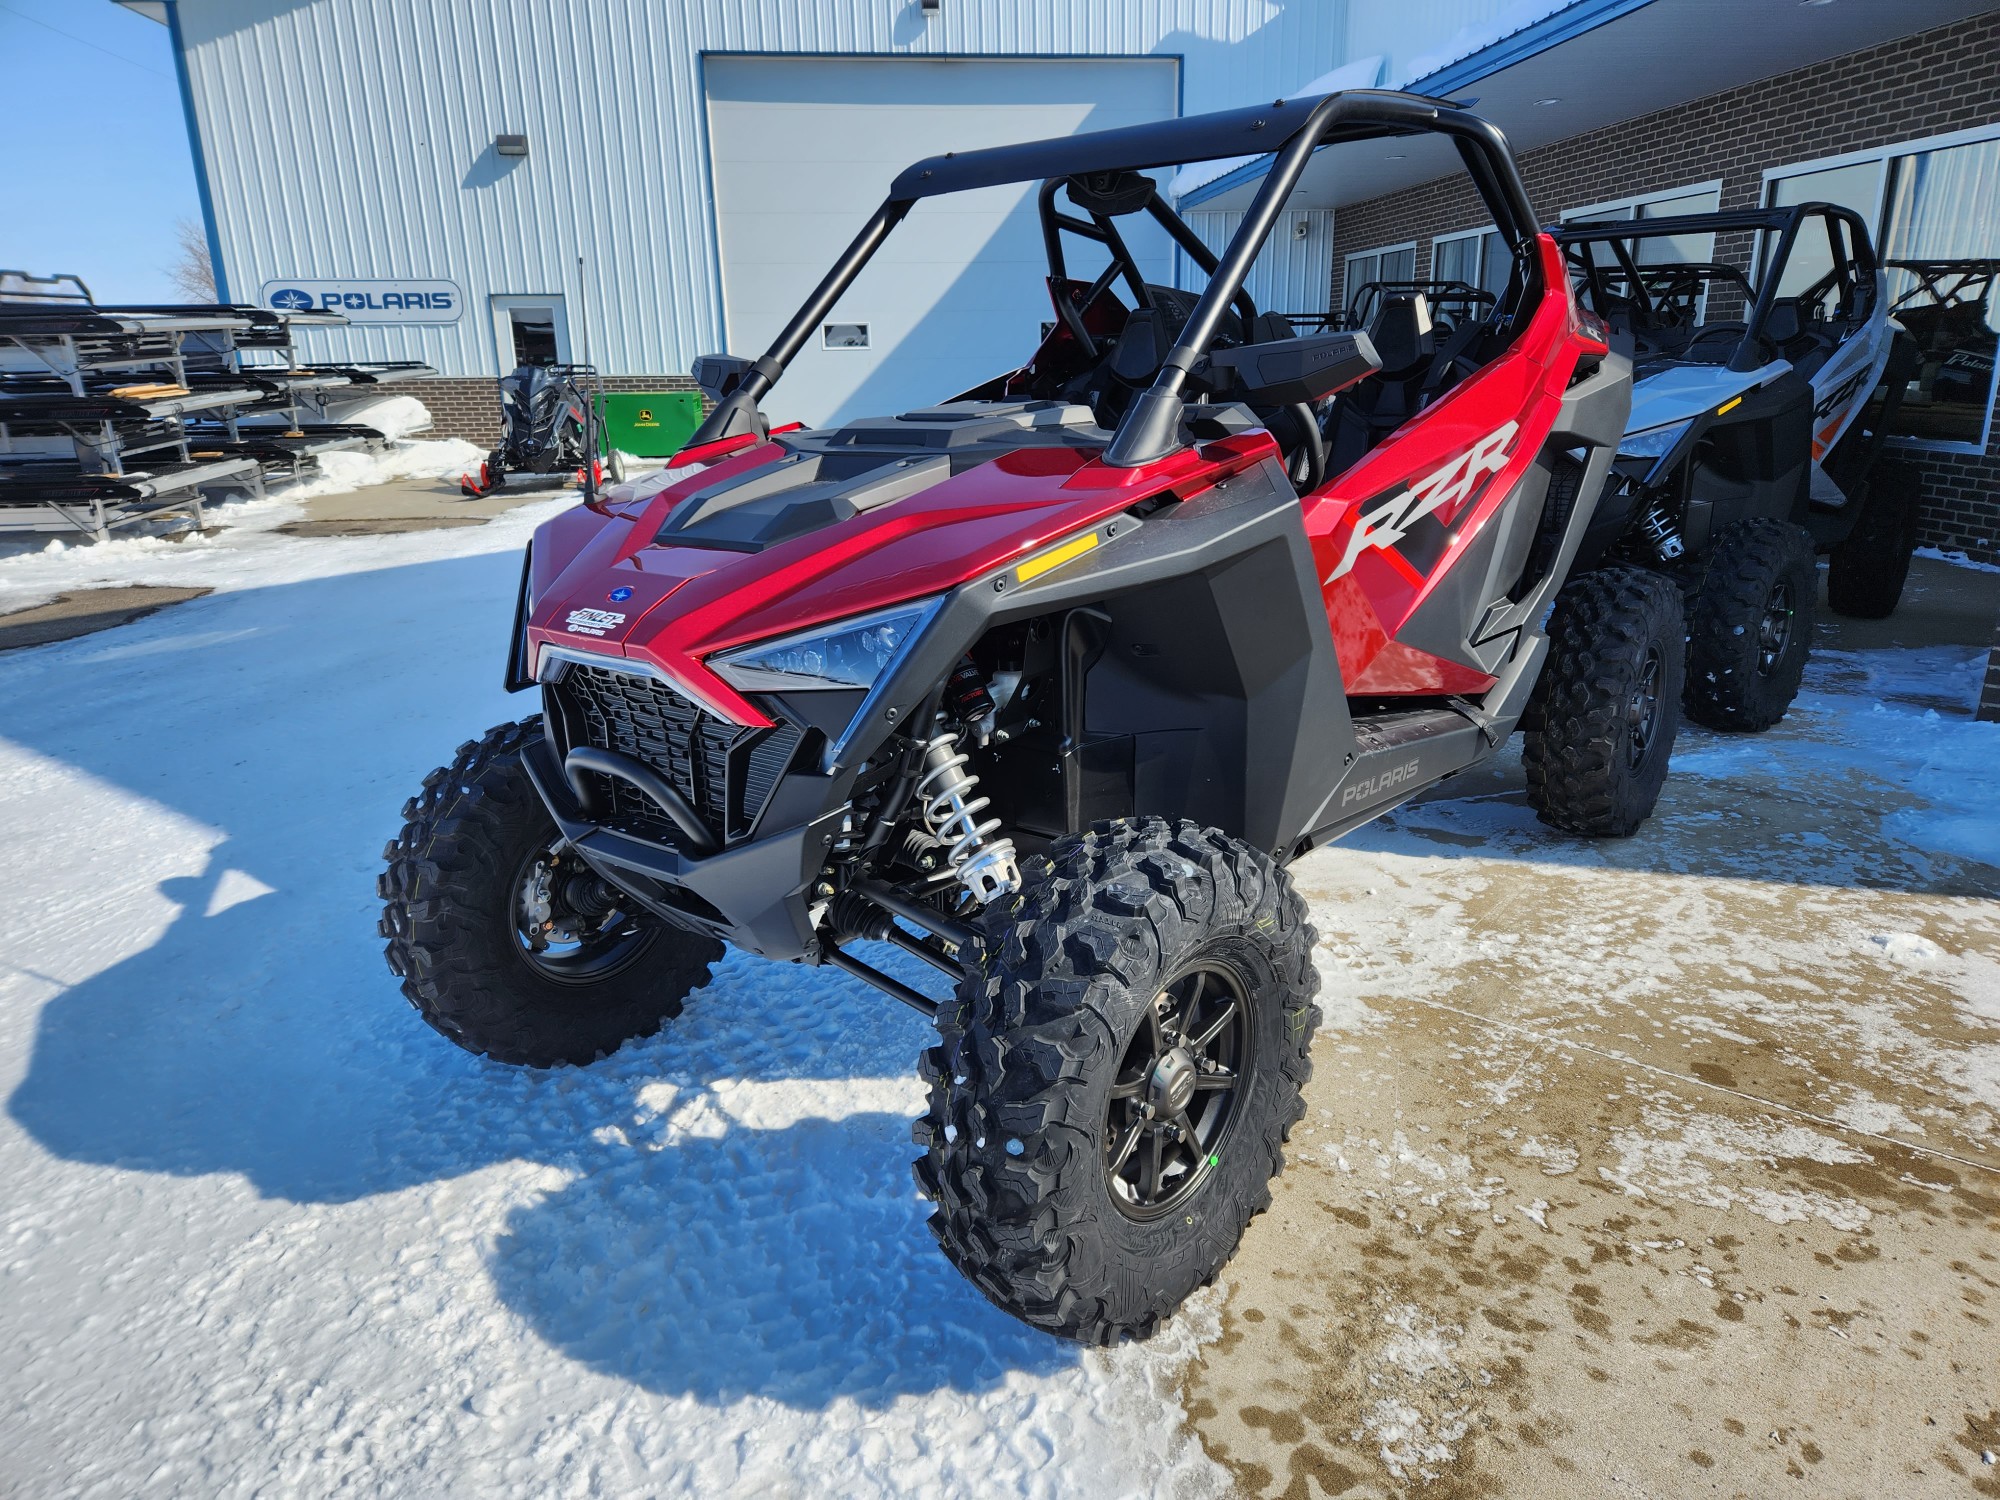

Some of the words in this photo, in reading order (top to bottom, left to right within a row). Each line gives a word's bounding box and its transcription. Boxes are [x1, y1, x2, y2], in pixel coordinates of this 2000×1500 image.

[321, 293, 452, 309] POLARIS
[1323, 420, 1519, 586] RZR
[577, 626, 606, 636] POLARIS
[1341, 757, 1419, 807] POLARIS
